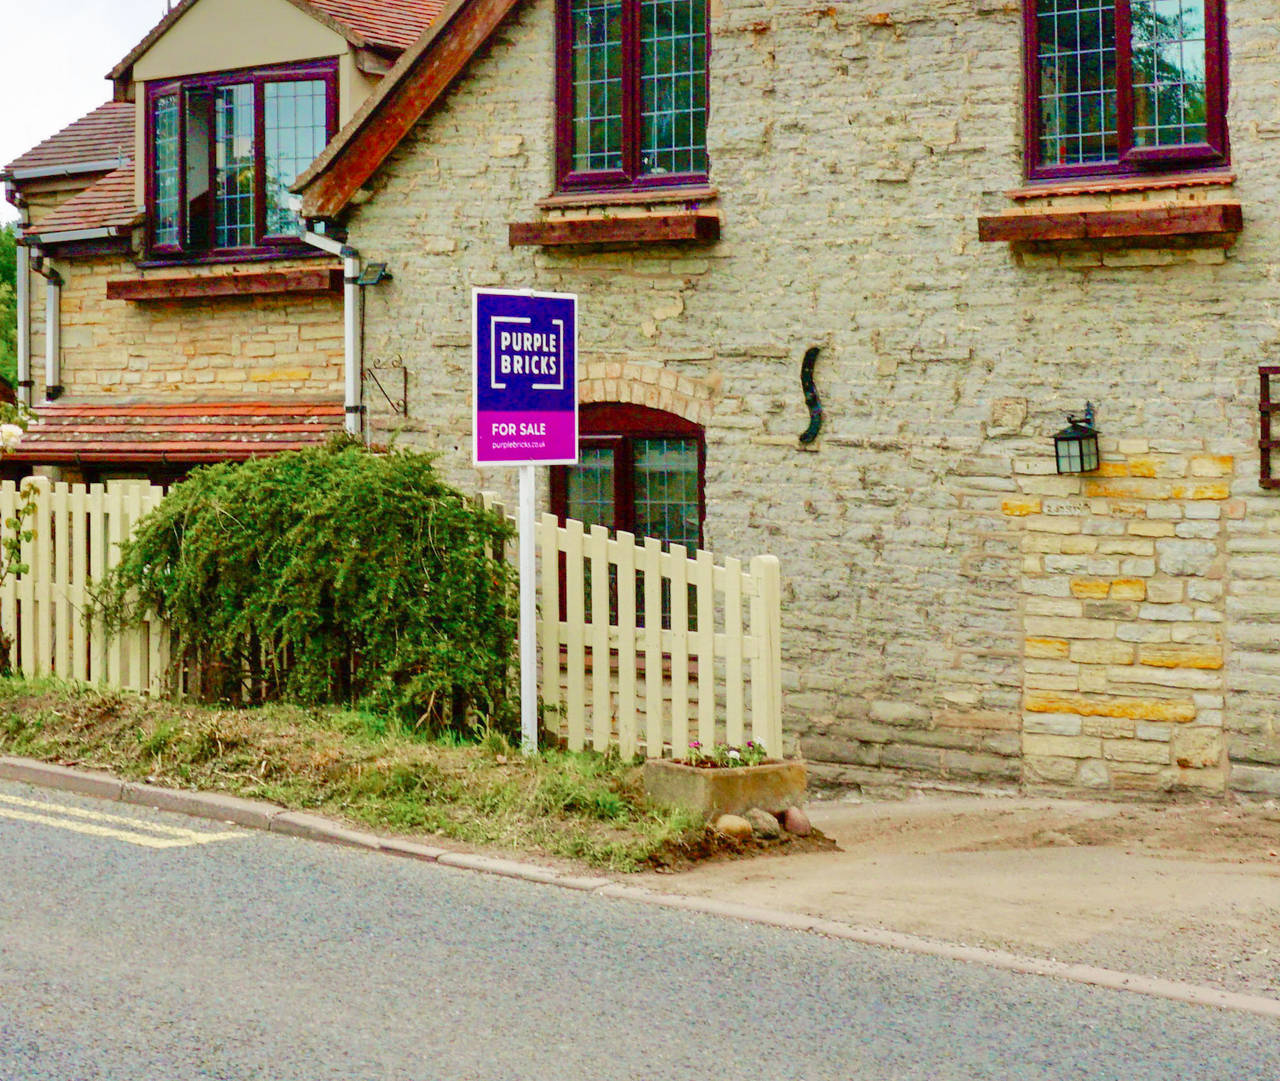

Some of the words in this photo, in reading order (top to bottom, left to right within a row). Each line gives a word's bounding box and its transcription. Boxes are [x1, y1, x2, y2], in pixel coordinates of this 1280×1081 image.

[500, 331, 557, 352] PURPLE
[500, 354, 557, 375] BRICKS
[491, 423, 517, 436] FOR
[519, 423, 547, 436] SALE
[491, 440, 546, 449] purplebricks.co.uk
